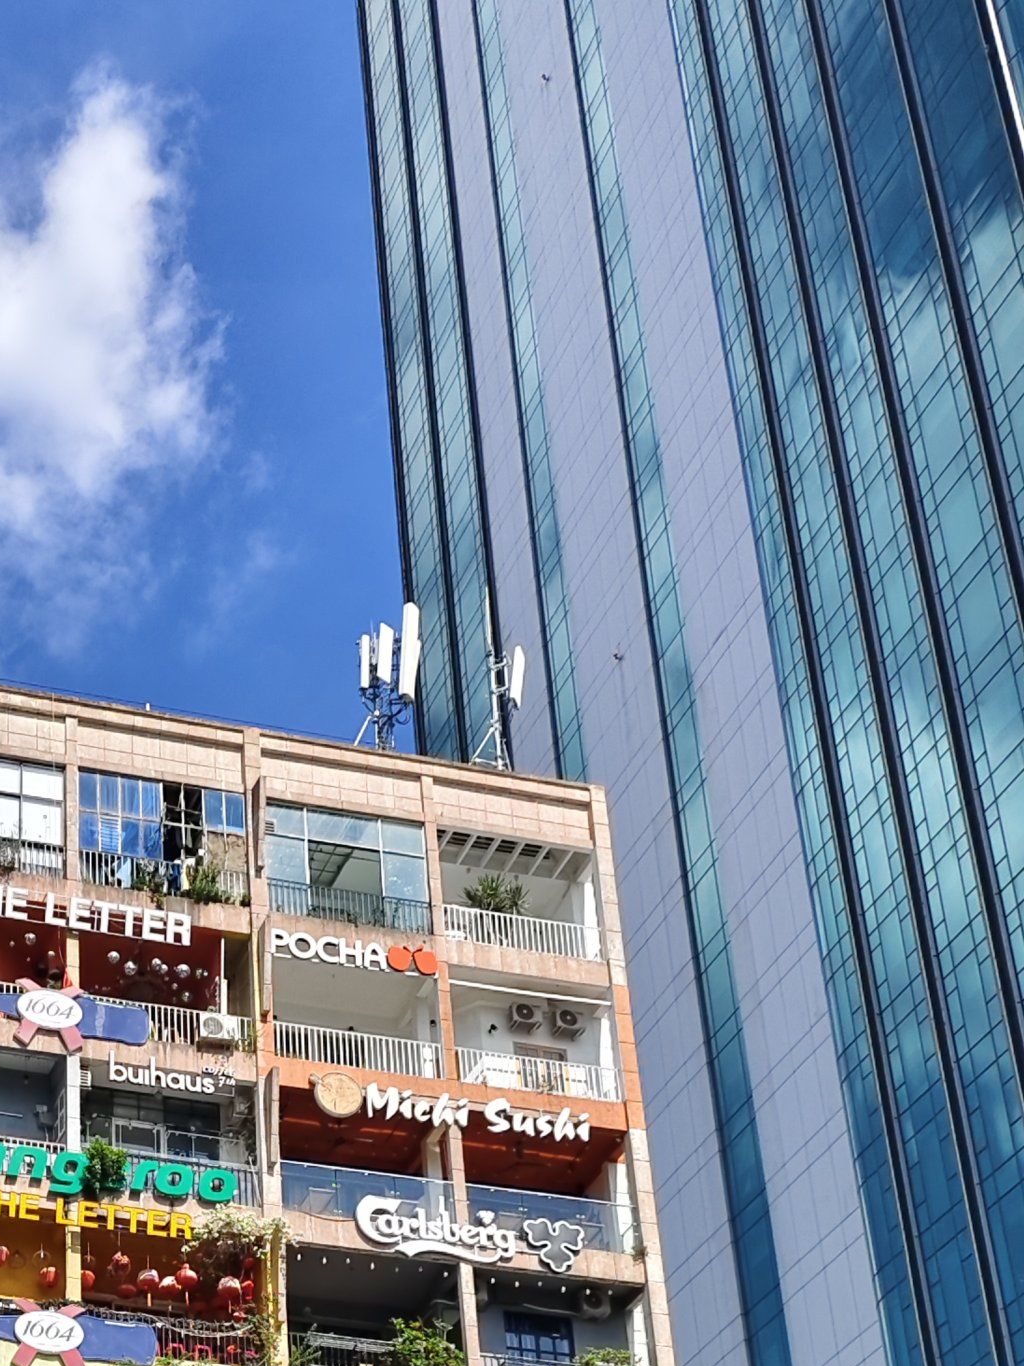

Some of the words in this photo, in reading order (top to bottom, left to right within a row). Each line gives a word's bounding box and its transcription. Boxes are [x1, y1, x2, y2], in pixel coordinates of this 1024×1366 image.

[45, 892, 192, 946] LETTER
[270, 929, 387, 971] POCHA
[25, 998, 75, 1020] 1664
[109, 1050, 215, 1095] buihaus
[366, 1083, 469, 1128] Michi
[484, 1098, 591, 1143] Sushi
[56, 1200, 193, 1240] LETTER
[355, 1195, 516, 1262] Carlsberg
[23, 1320, 76, 1342] 1664
